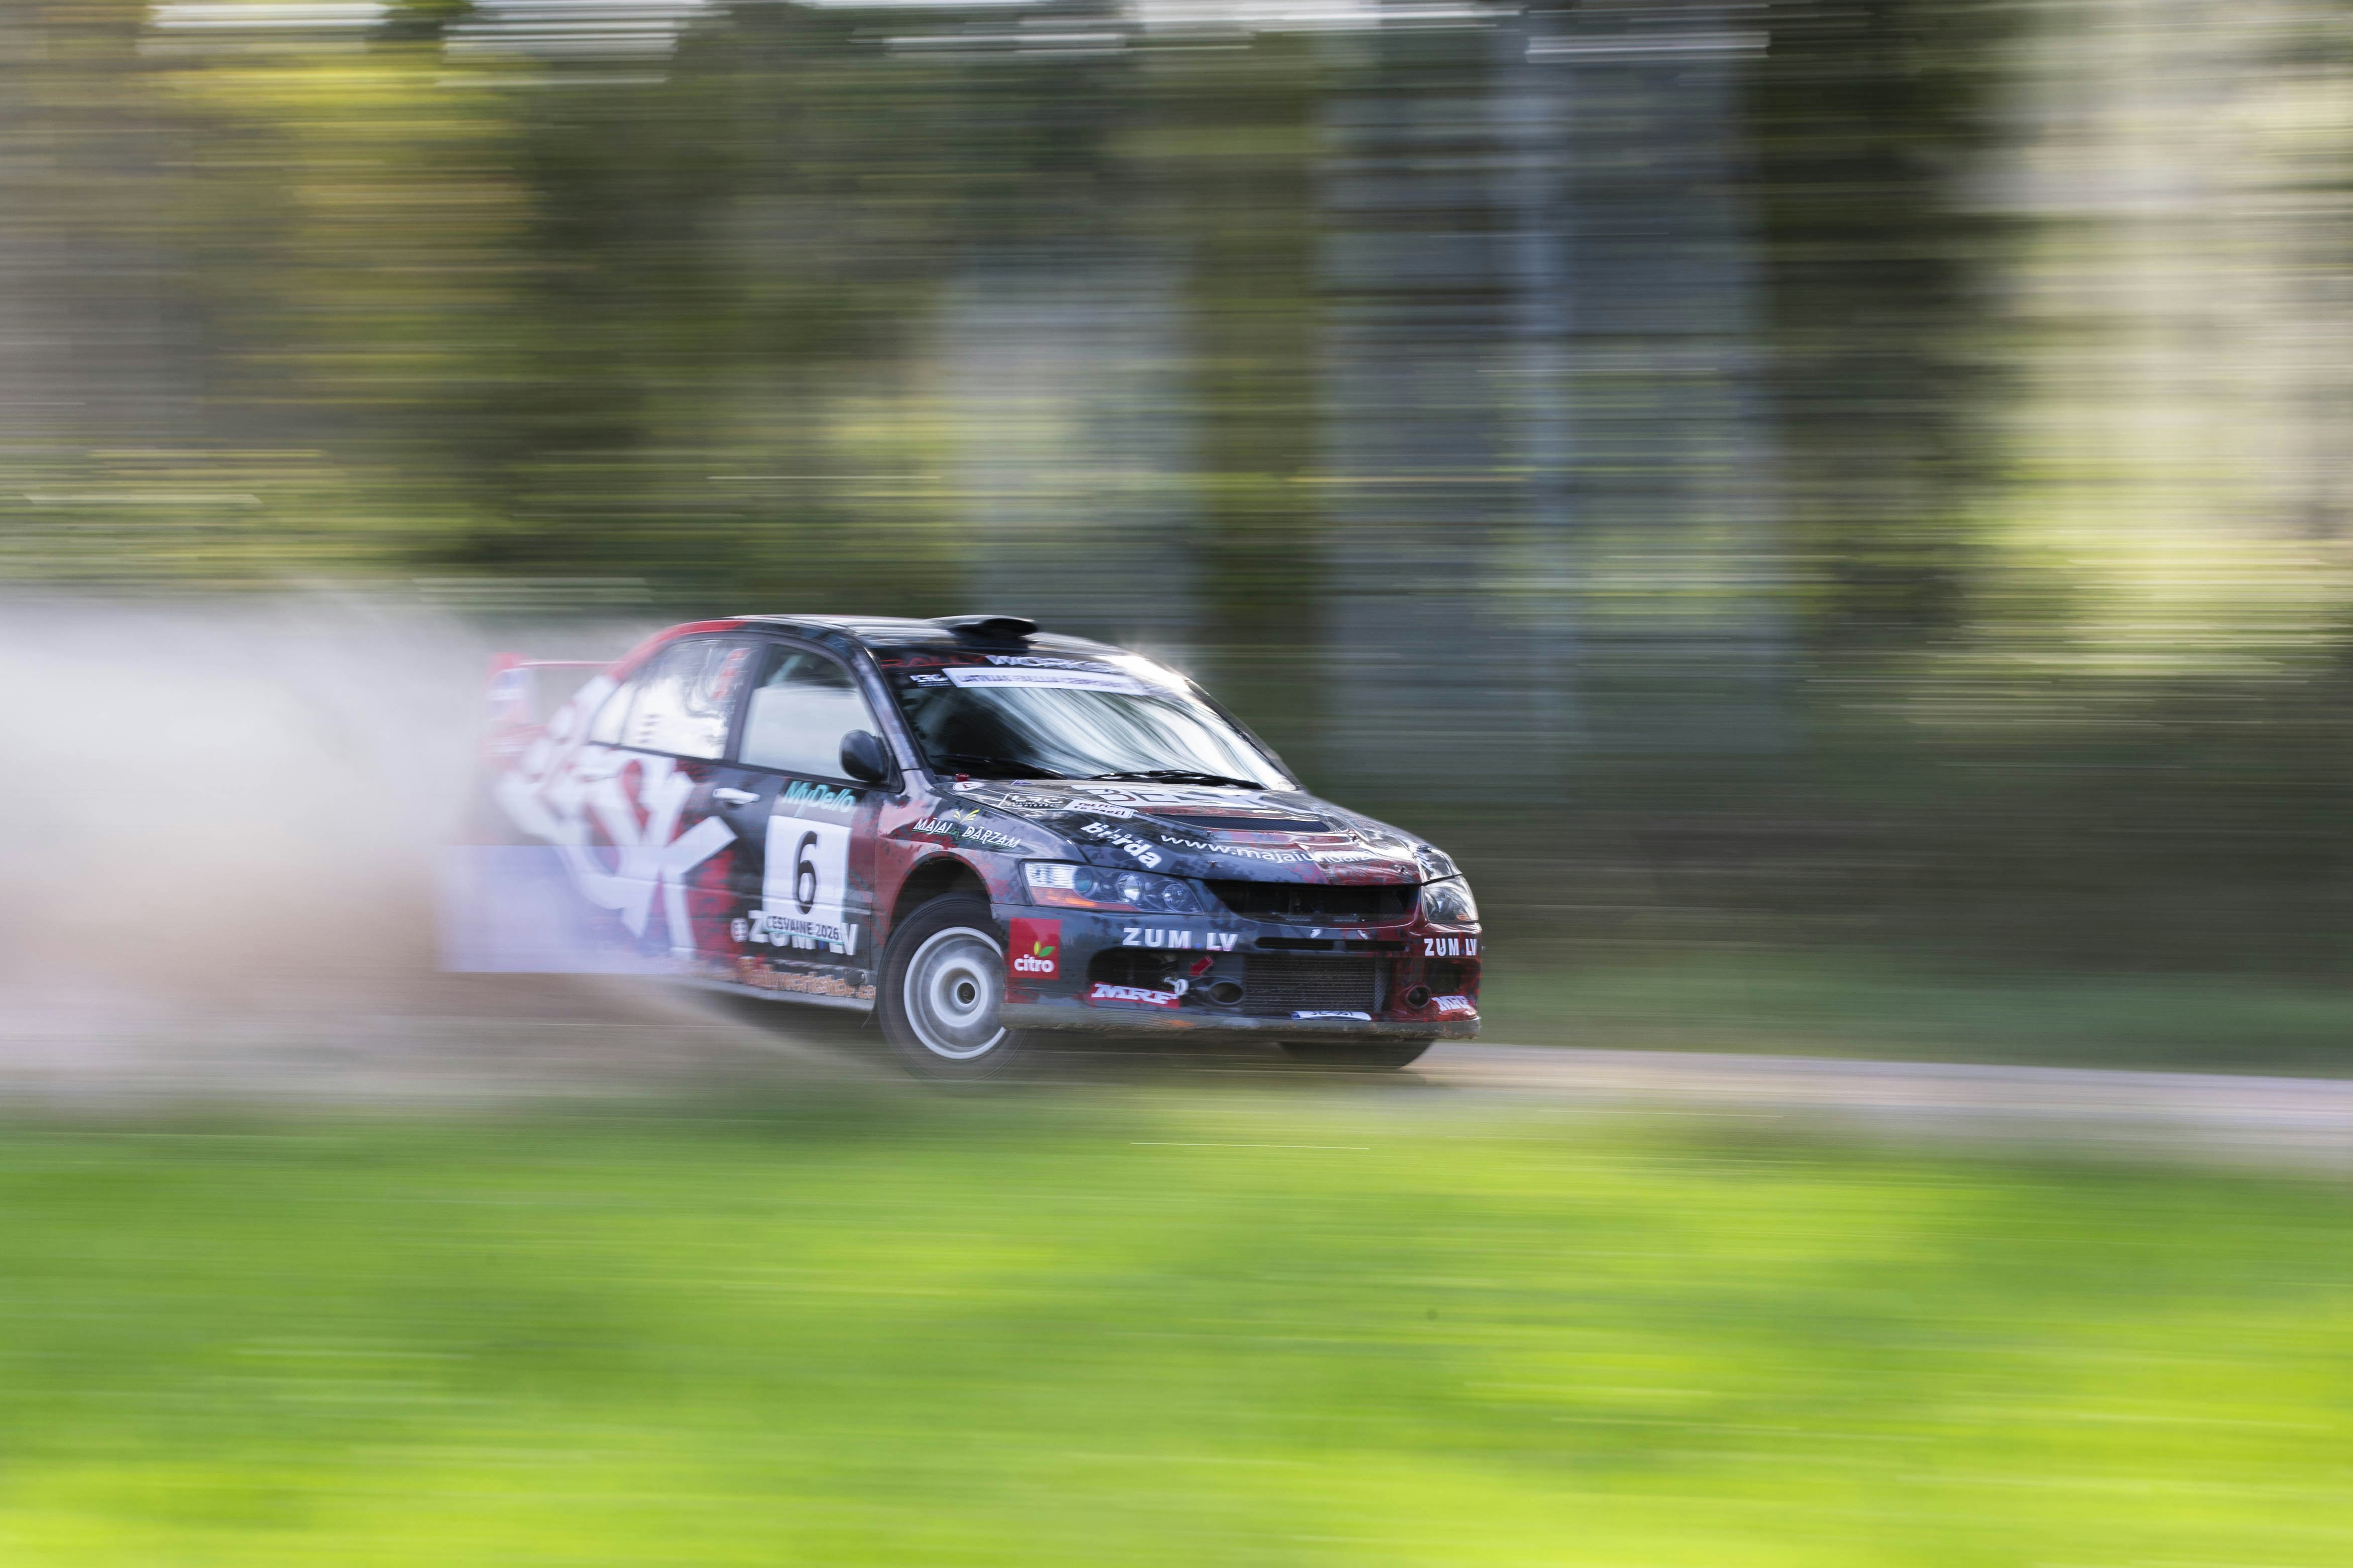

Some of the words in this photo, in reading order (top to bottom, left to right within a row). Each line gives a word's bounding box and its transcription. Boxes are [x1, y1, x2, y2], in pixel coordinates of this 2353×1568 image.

[793, 830, 819, 915] 6
[766, 915, 812, 936] CESVAINE
[1122, 927, 1239, 951] ZUM.LV
[1424, 938, 1478, 956] ZUM.LV
[1014, 954, 1054, 973] citro
[1091, 983, 1178, 1004] MRF
